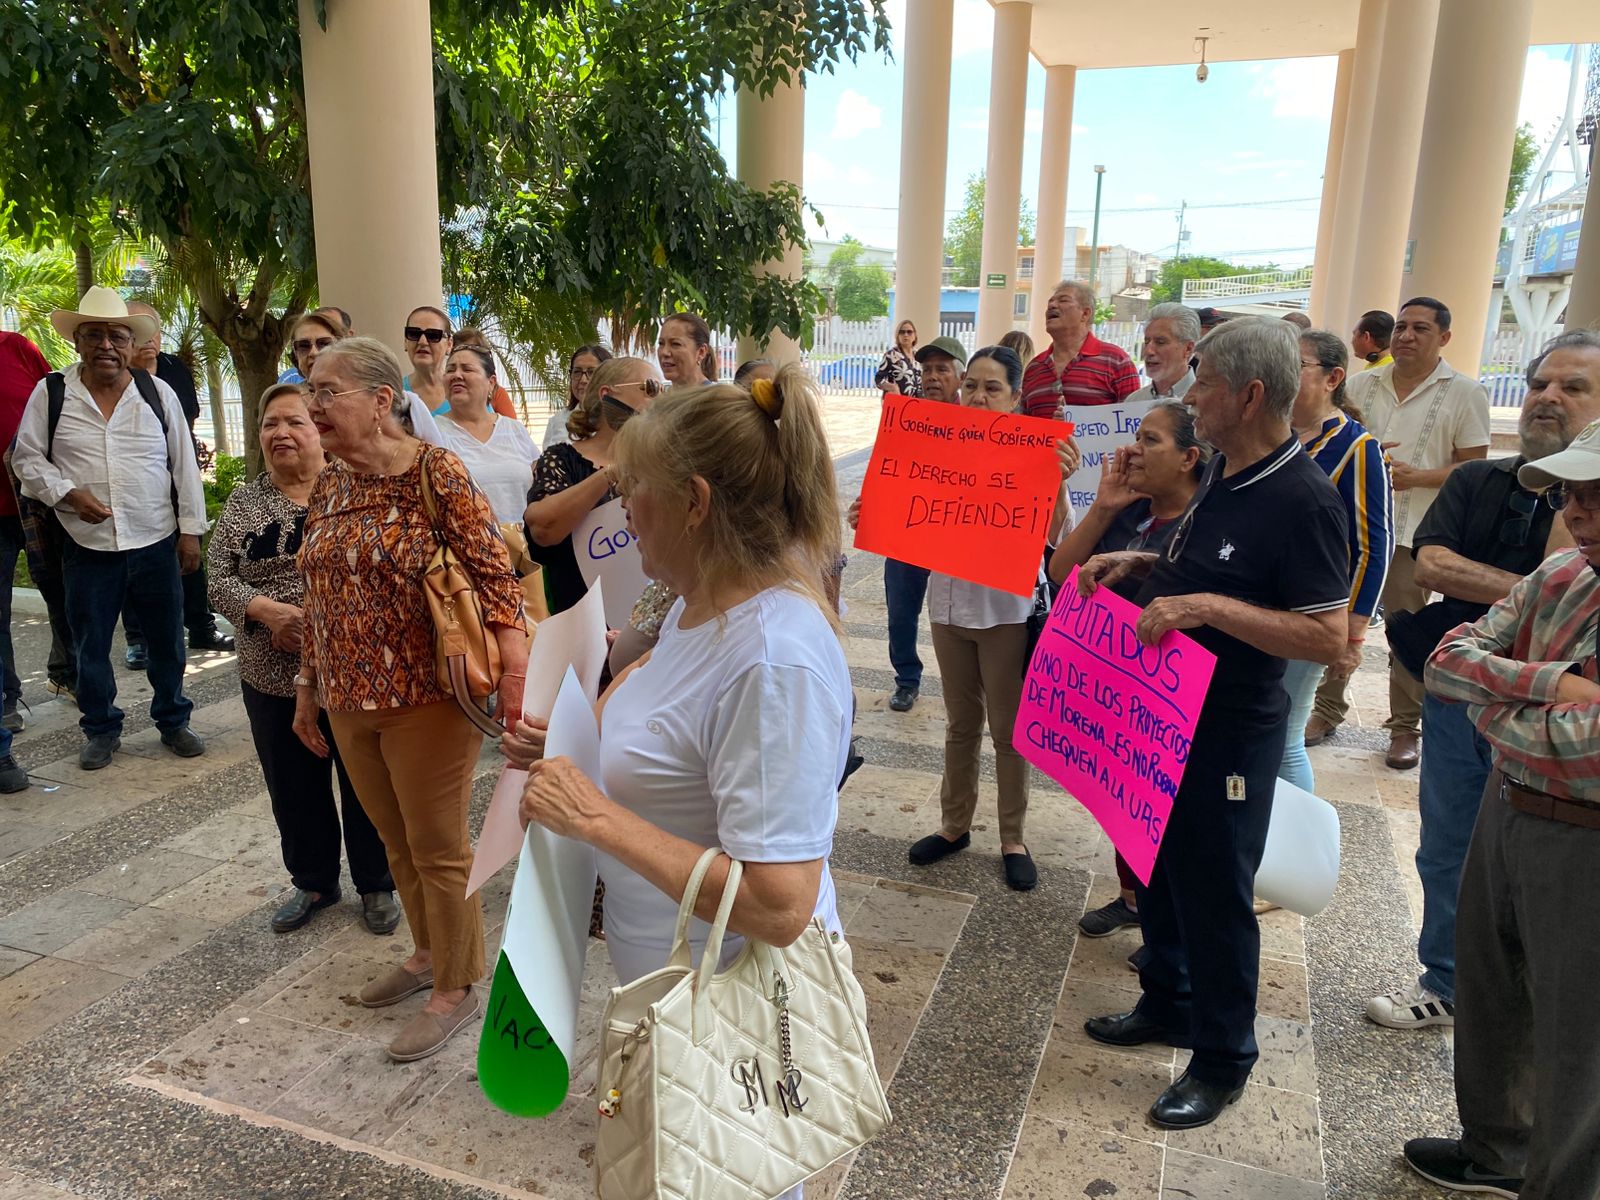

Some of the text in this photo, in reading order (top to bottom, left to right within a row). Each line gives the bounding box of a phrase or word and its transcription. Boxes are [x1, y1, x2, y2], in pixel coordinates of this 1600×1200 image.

[880, 457, 1018, 490] EL DERECHO SE
[1053, 581, 1183, 693] DIPUTADOS
[1027, 677, 1047, 708] DE
[1032, 646, 1192, 764] UNO DE LOS PROYECTOS
[1099, 766, 1110, 791] A
[1110, 777, 1124, 810] LA
[1129, 792, 1162, 846] UAS
[492, 993, 554, 1052] VAC
